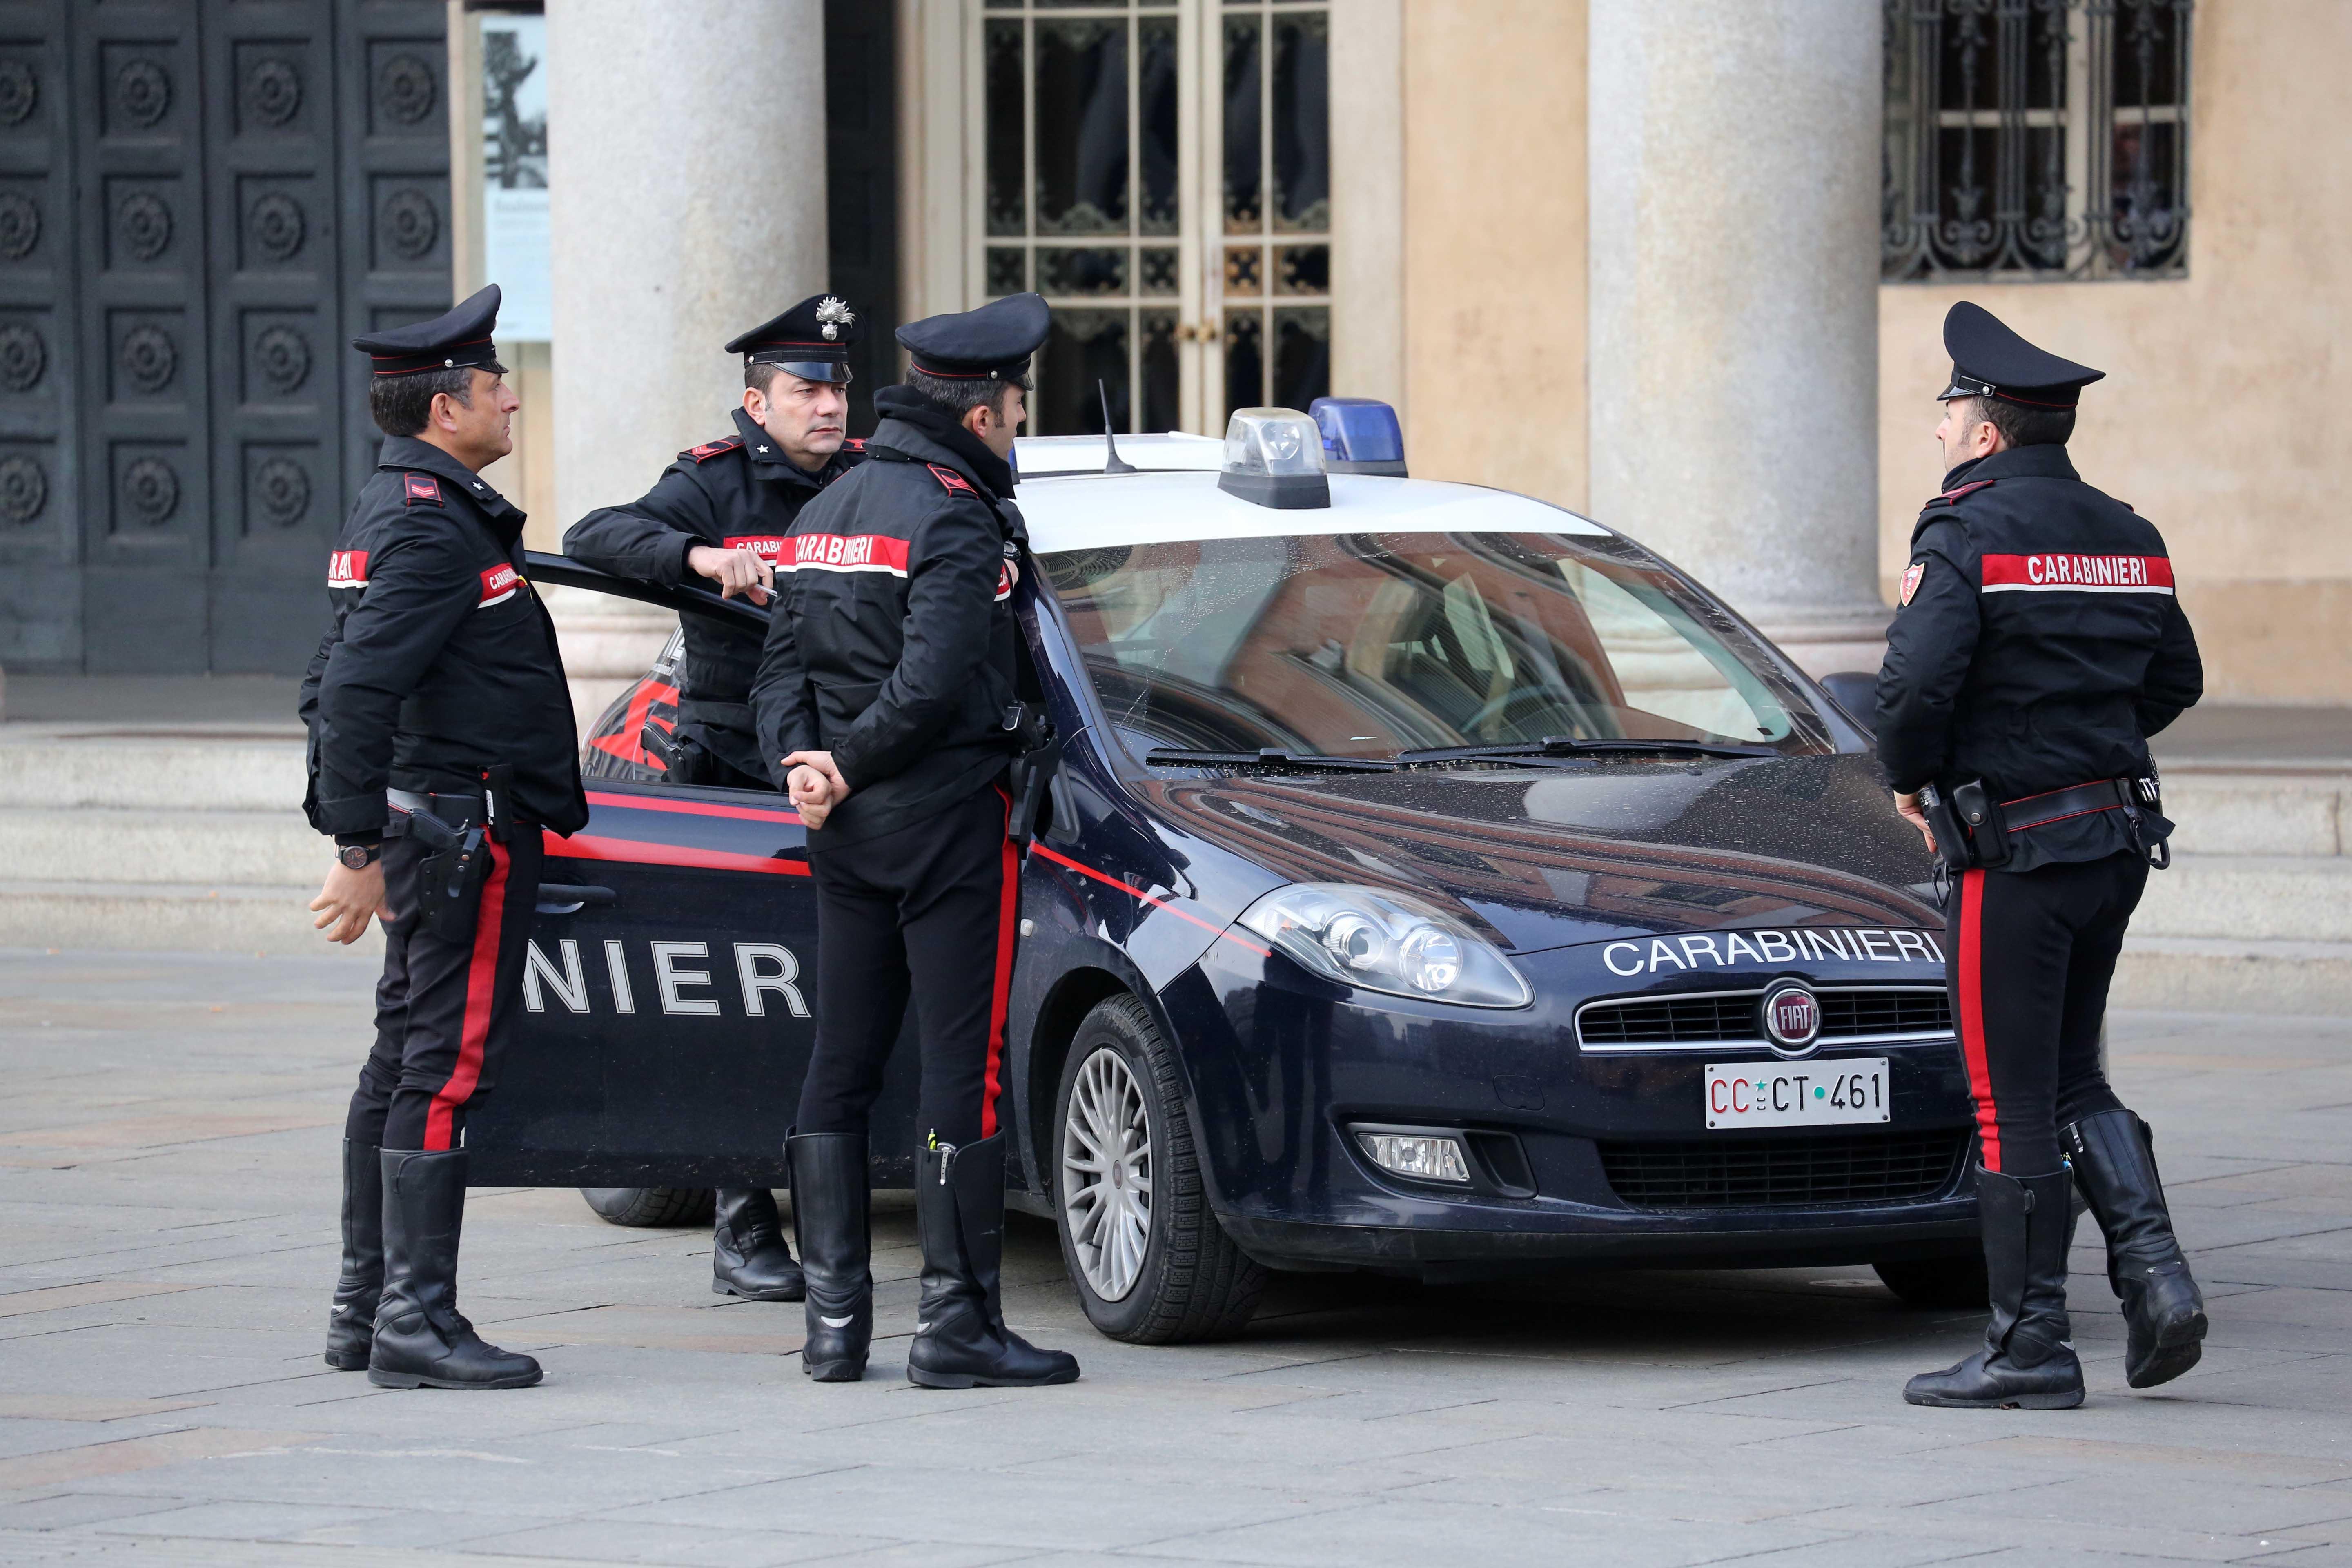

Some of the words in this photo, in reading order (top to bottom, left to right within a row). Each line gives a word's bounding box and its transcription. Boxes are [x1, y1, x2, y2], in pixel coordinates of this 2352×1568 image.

[736, 541, 782, 554] CARABI
[2027, 556, 2148, 585] CARABINIERI
[1602, 930, 1946, 976] CARABINIERI
[522, 938, 811, 1017] NIER
[1780, 1005, 1809, 1030] FIAT
[1711, 1078, 1749, 1114] CC
[1773, 1075, 1809, 1111] CT
[1830, 1073, 1879, 1109] 461
